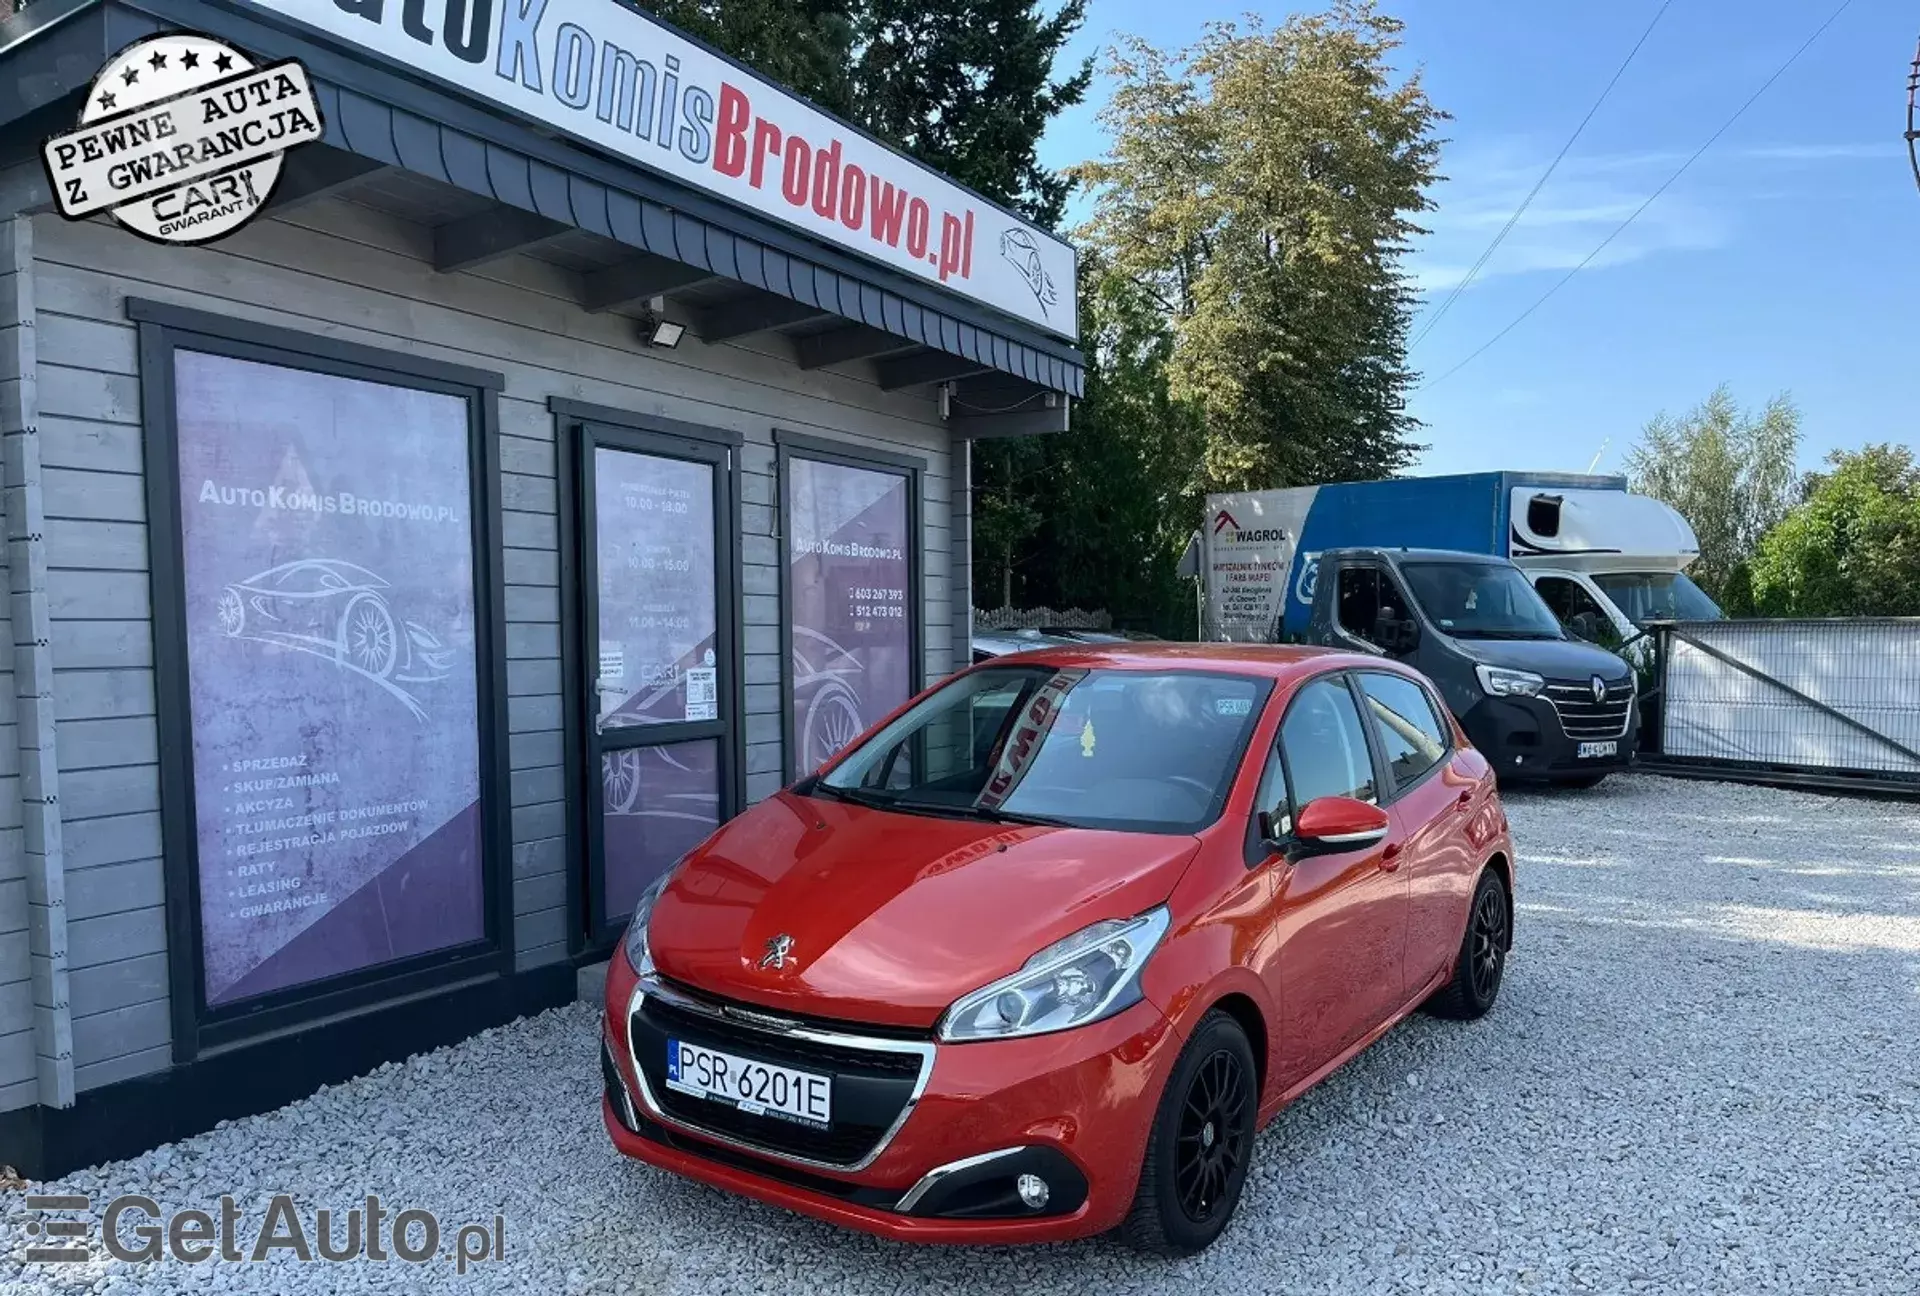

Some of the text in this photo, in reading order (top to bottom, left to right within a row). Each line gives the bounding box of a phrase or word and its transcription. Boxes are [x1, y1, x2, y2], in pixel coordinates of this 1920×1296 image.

[333, 0, 974, 282] oKomisBrodowo.pl
[1236, 529, 1286, 542] WAGROL
[234, 798, 294, 816] AKCYZA
[236, 833, 336, 857] REJESTRACJA
[238, 861, 277, 877] RATY
[238, 877, 301, 898] LEASING
[240, 892, 328, 919] GWARANCJE
[680, 1046, 826, 1118] PSR 6201E
